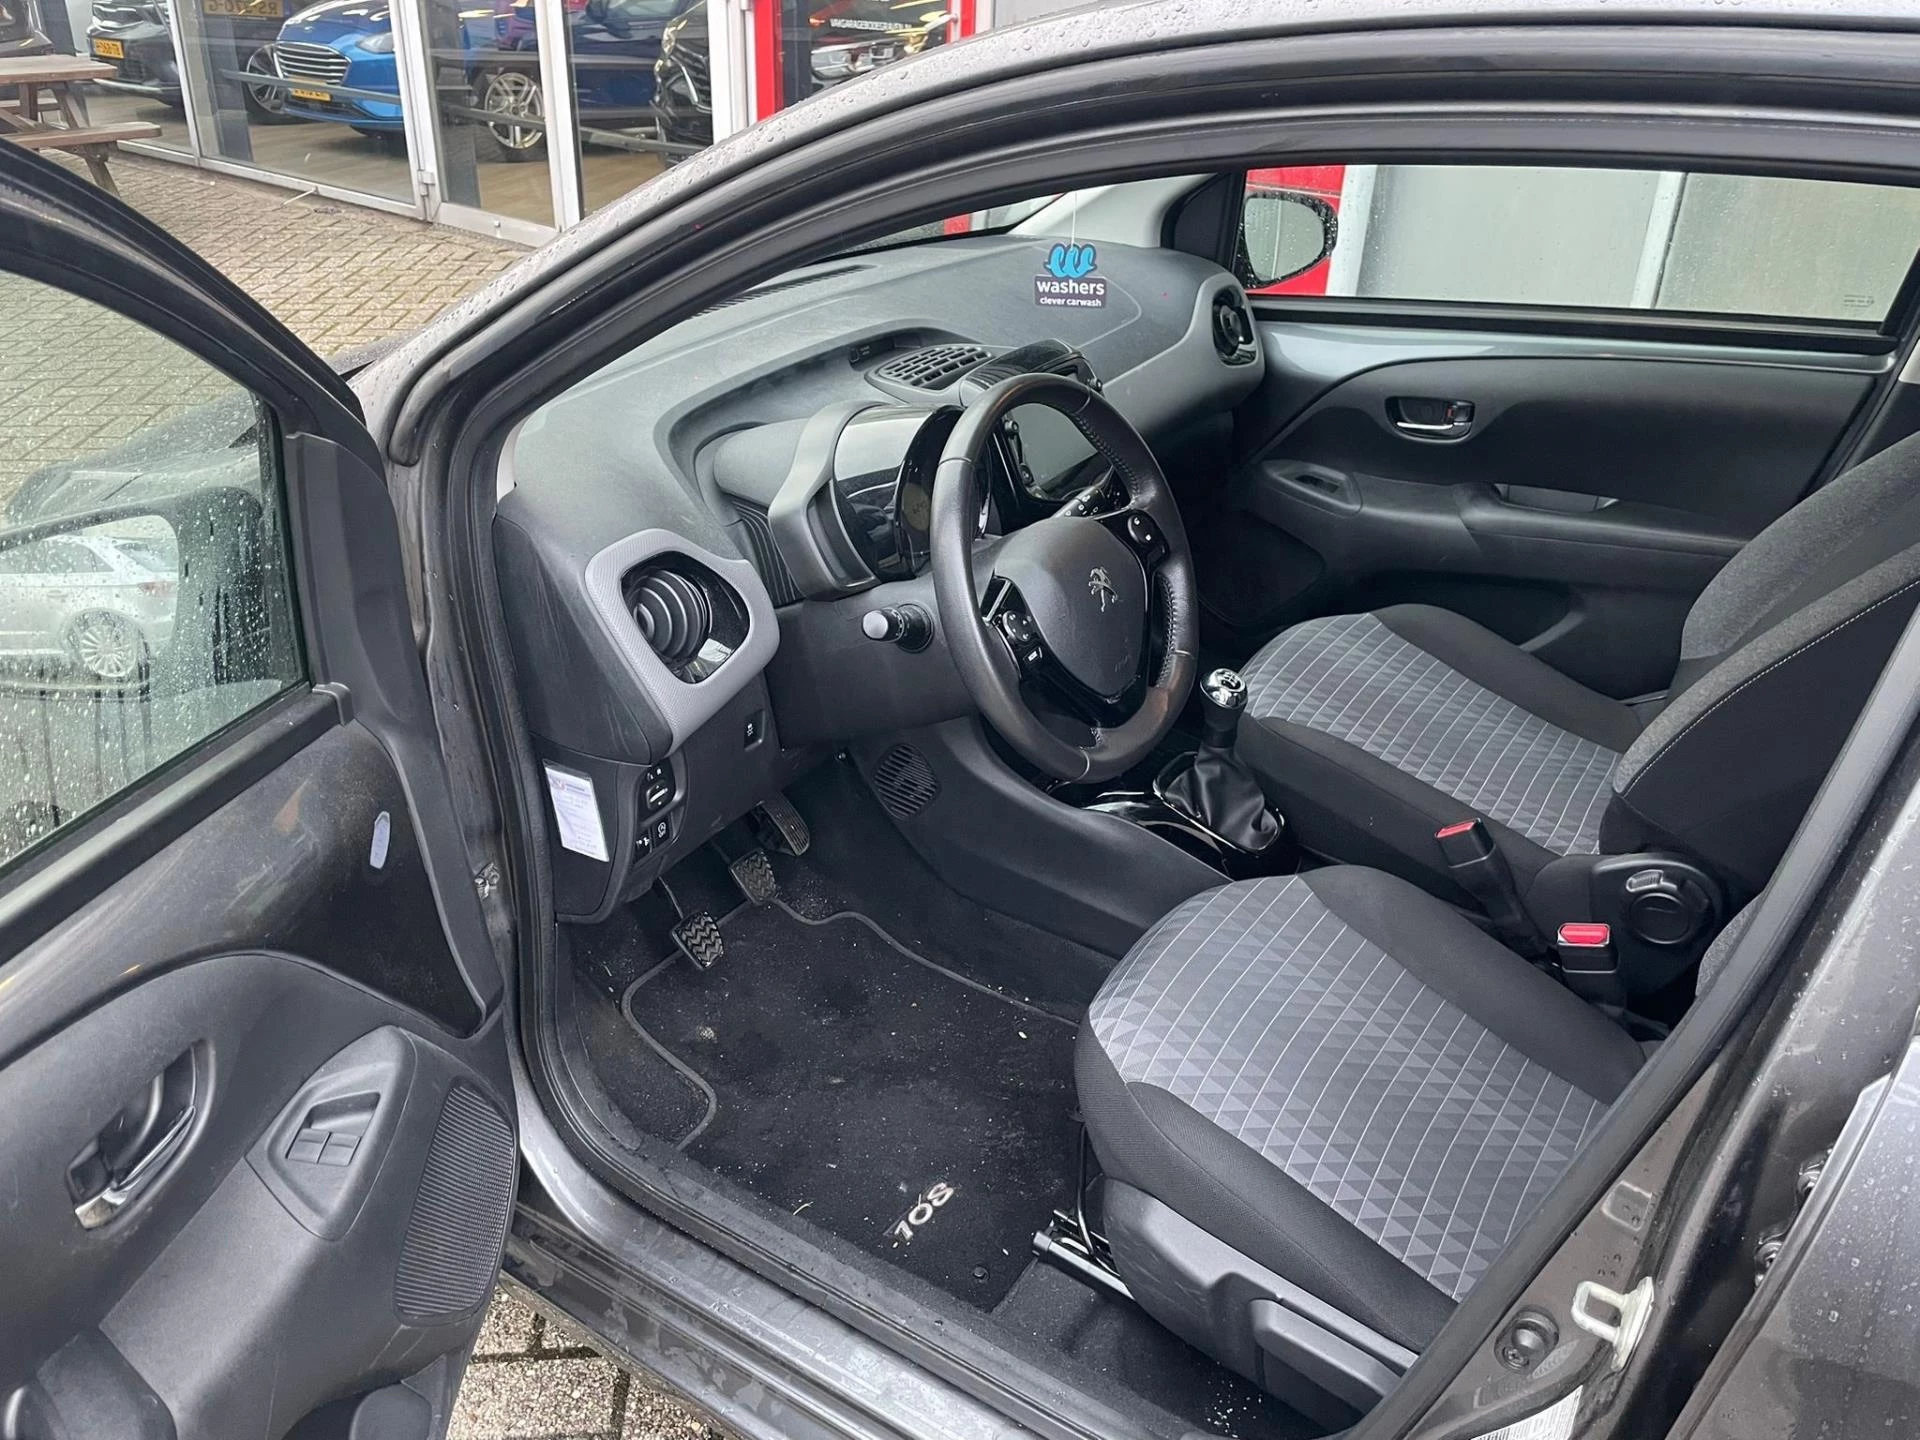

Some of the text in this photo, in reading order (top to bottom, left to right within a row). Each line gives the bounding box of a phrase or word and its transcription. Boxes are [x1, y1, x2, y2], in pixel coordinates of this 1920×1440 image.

[1037, 280, 1104, 295] washers
[1040, 297, 1101, 307] clever carwash
[894, 1182, 954, 1240] 108
